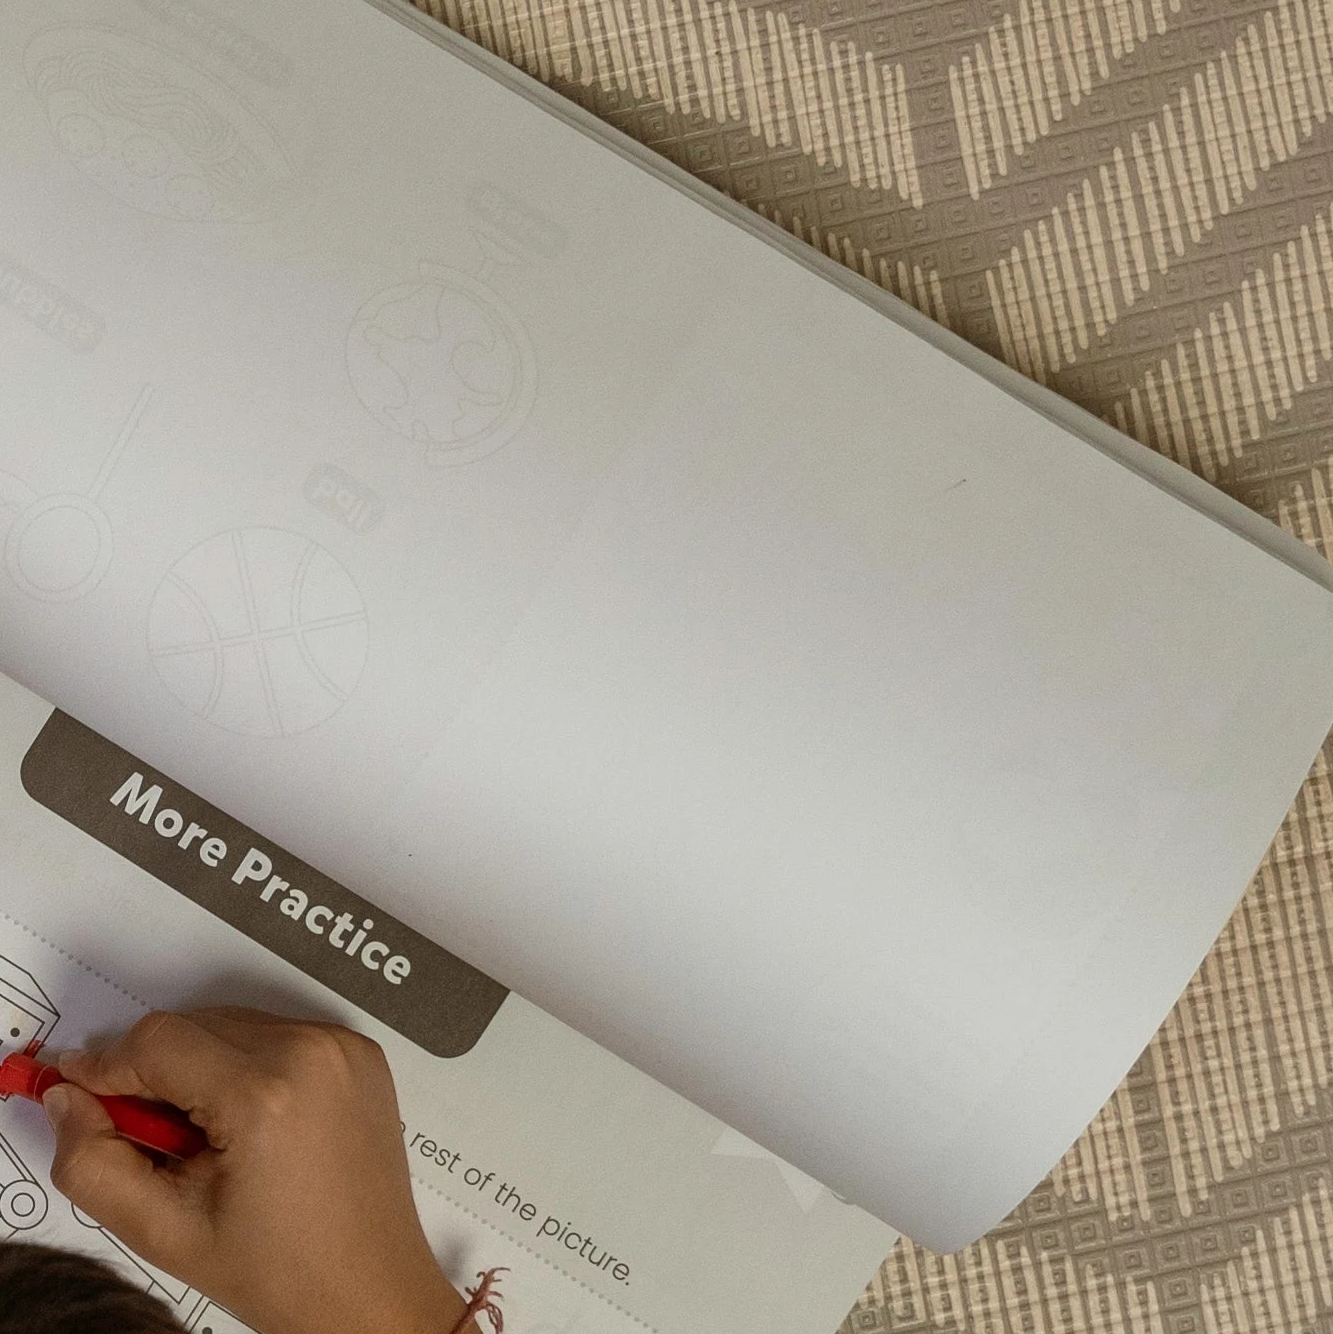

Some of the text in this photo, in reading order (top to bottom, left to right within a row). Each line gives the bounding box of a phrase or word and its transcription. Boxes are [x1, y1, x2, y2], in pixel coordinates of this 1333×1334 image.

[106, 767, 425, 988] More Practice
[407, 1129, 641, 1288] rest of the picture.
